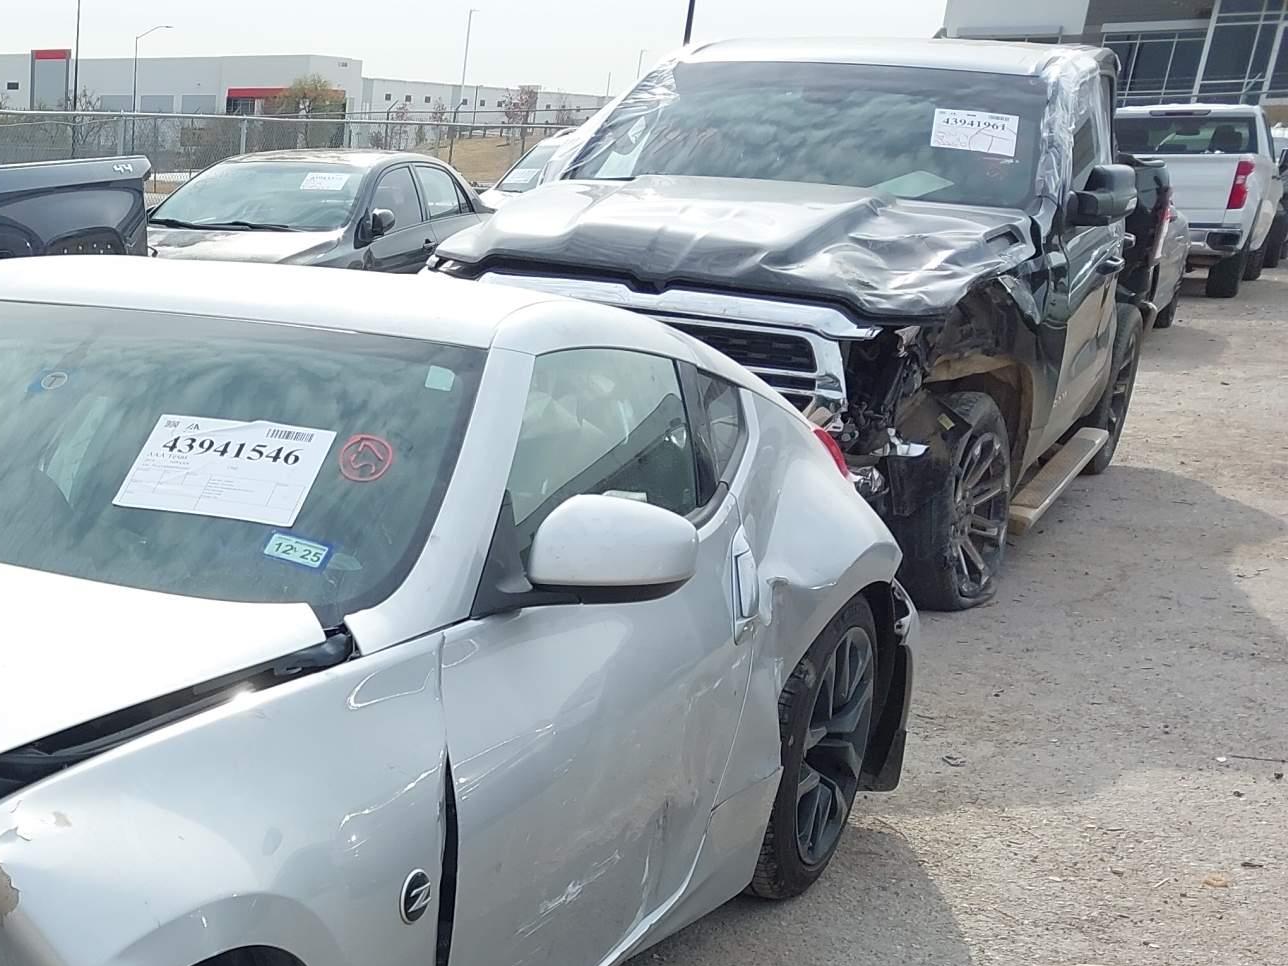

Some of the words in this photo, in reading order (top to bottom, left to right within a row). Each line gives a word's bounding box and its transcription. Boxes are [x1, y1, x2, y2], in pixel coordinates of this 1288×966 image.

[942, 117, 1007, 131] 43941961
[162, 435, 304, 465] 43941546
[275, 542, 294, 555] 12
[299, 548, 323, 563] 25
